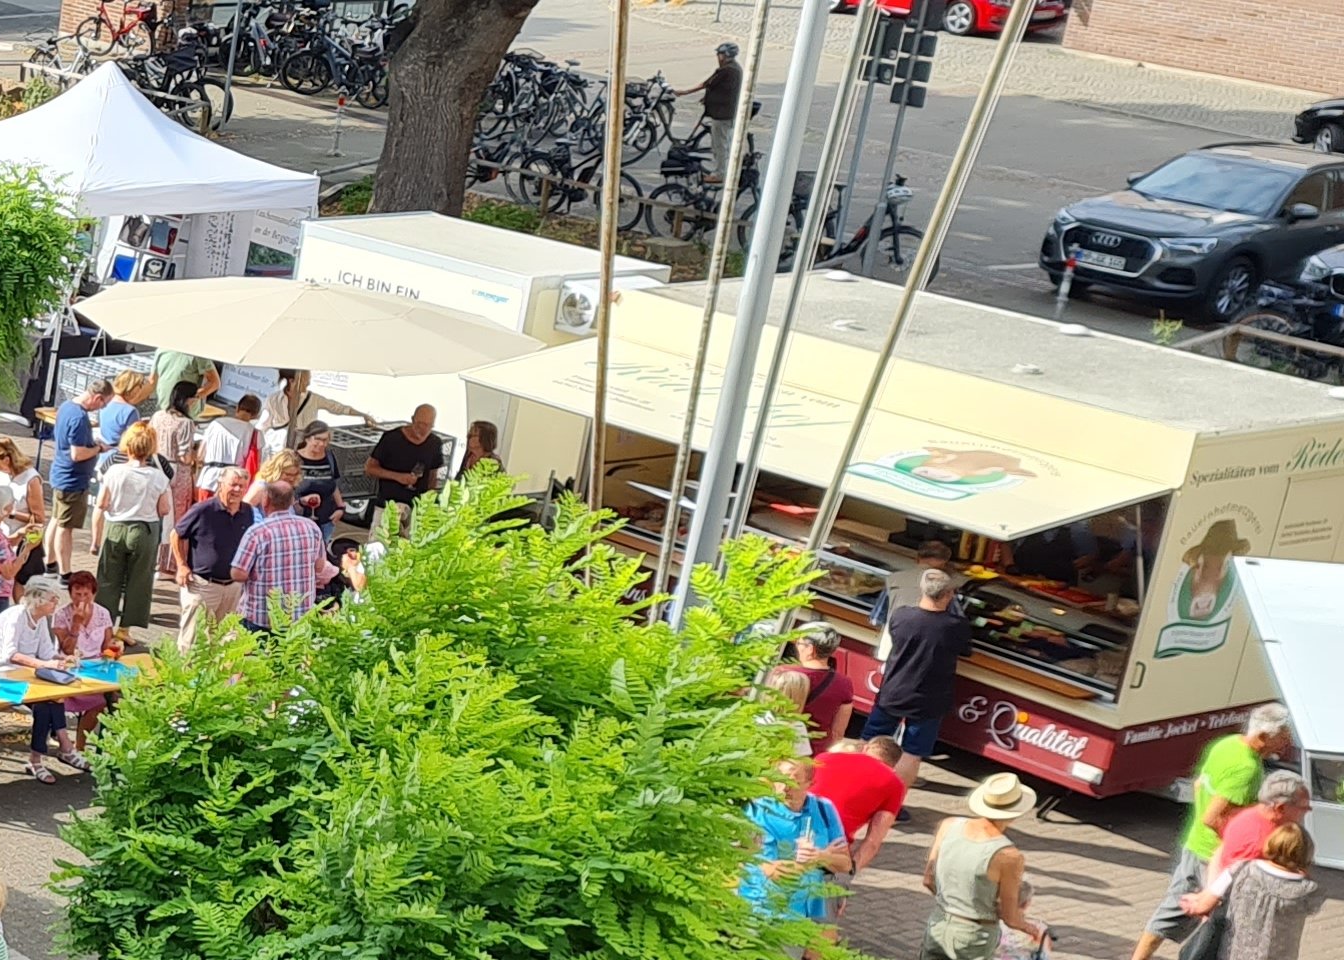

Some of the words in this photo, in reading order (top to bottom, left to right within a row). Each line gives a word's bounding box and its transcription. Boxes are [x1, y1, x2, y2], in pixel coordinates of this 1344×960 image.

[338, 269, 363, 288] ICH
[367, 278, 391, 294] BIN
[1189, 465, 1256, 488] Spezialitäten
[1258, 463, 1280, 475] vom
[958, 695, 988, 723] &
[986, 700, 1090, 760] Qualität
[1123, 725, 1164, 746] Familie
